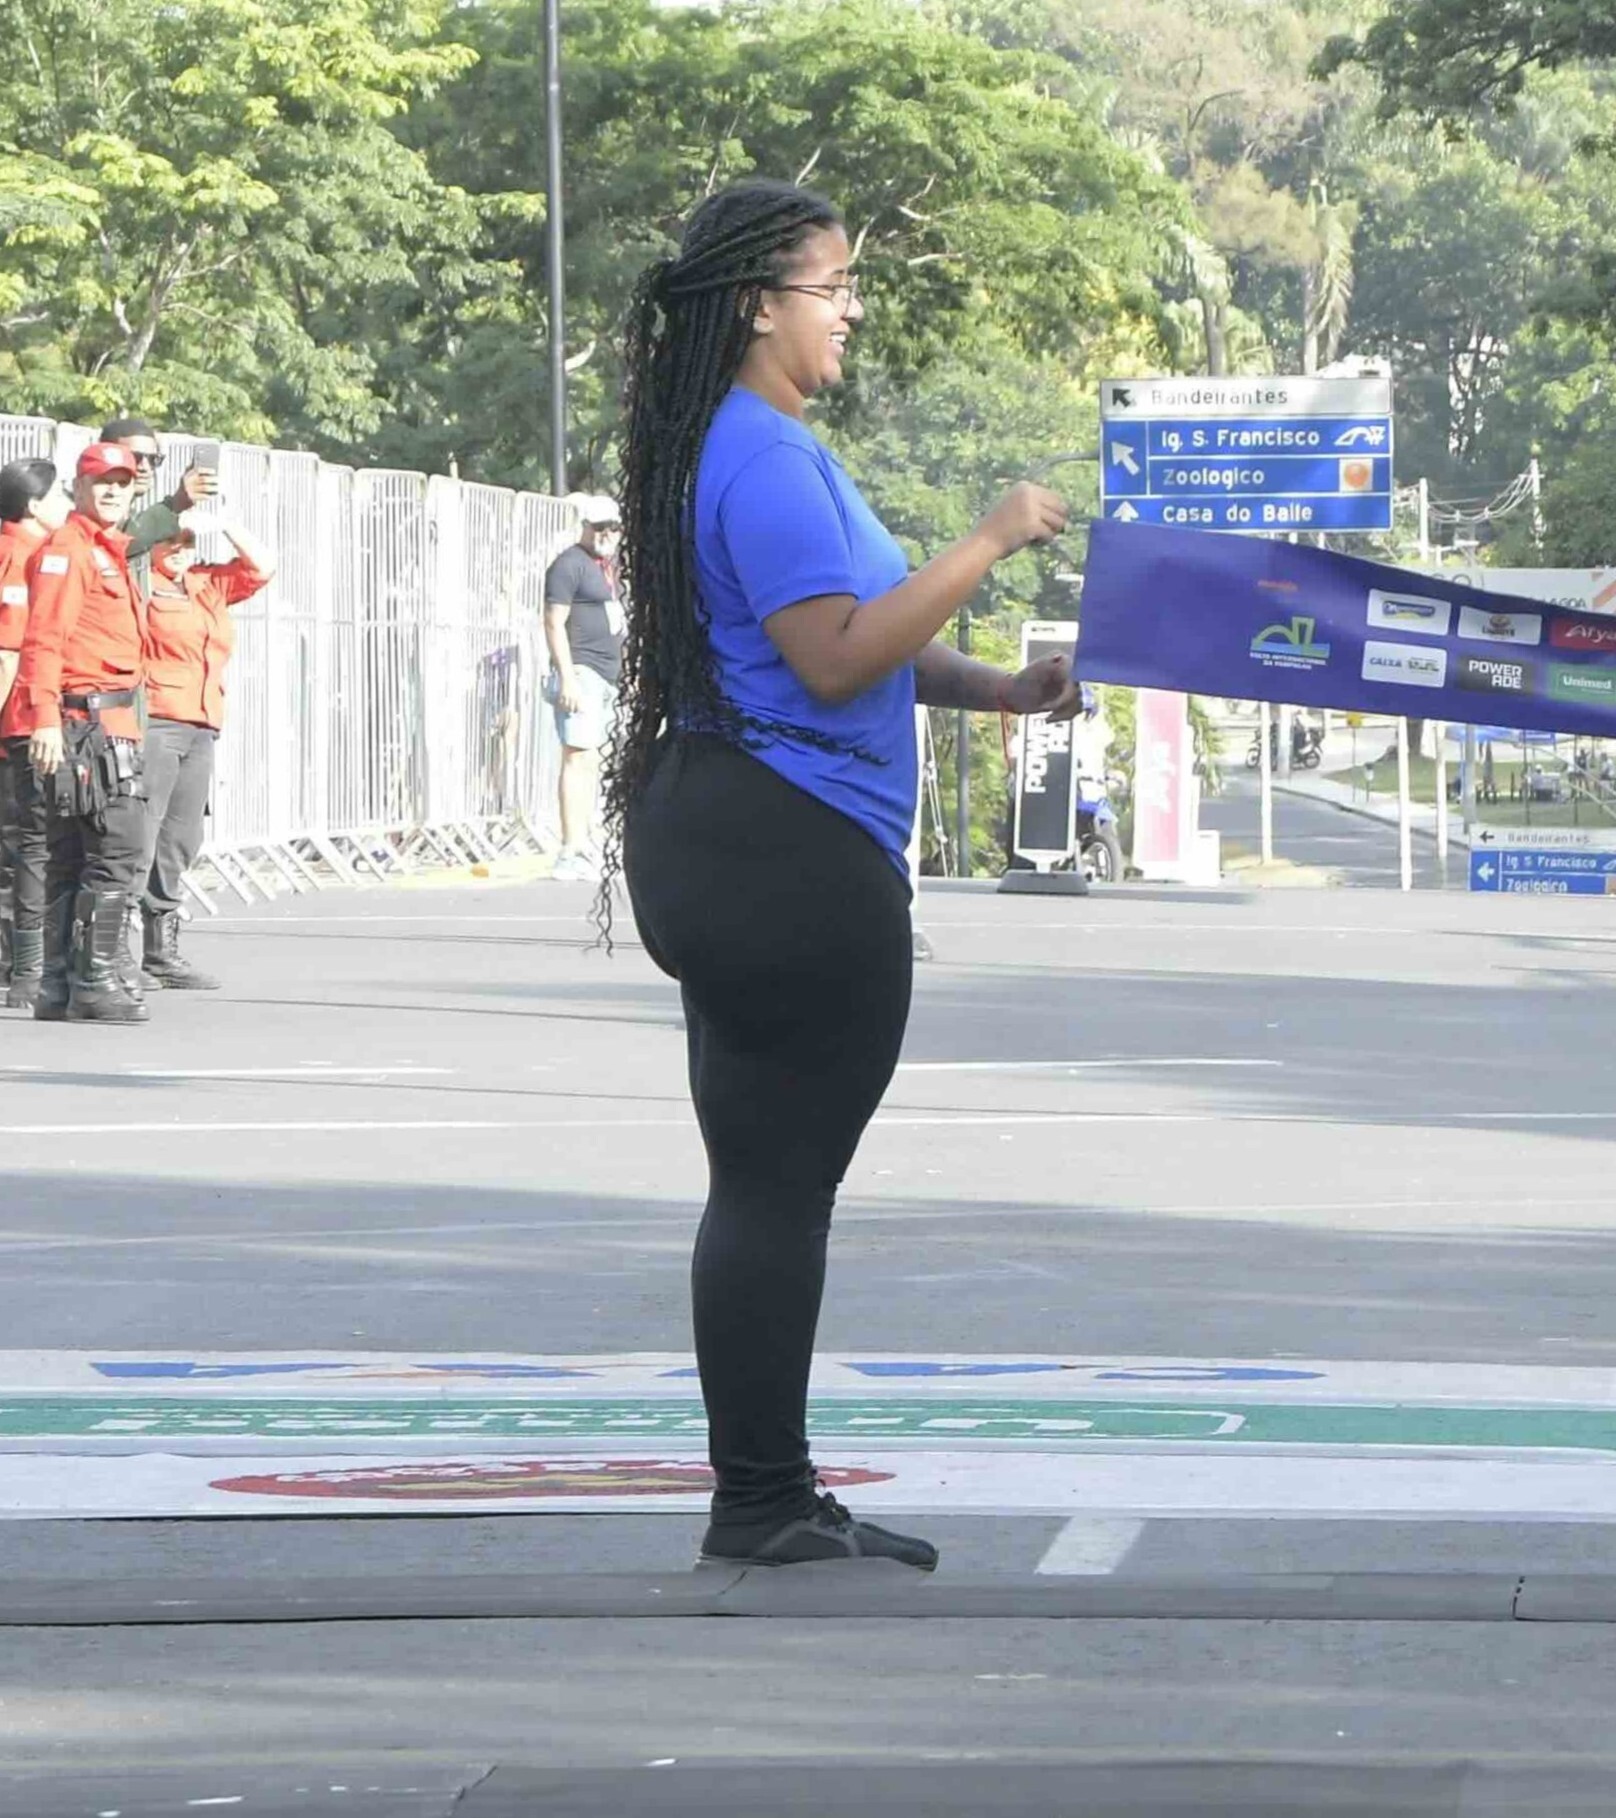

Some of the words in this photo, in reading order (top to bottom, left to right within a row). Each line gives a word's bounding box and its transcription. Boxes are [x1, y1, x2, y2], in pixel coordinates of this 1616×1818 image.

[1151, 387, 1290, 405] Bandeirantes
[1217, 428, 1321, 447] Francisco
[1162, 505, 1214, 524] Casa
[1226, 504, 1251, 523] do
[1263, 503, 1314, 523] Baile
[1468, 659, 1523, 678] POWER
[1491, 674, 1522, 690] ADE
[1562, 674, 1613, 690] Unimed
[1024, 713, 1047, 794] POWE
[1537, 855, 1598, 869] Francisco
